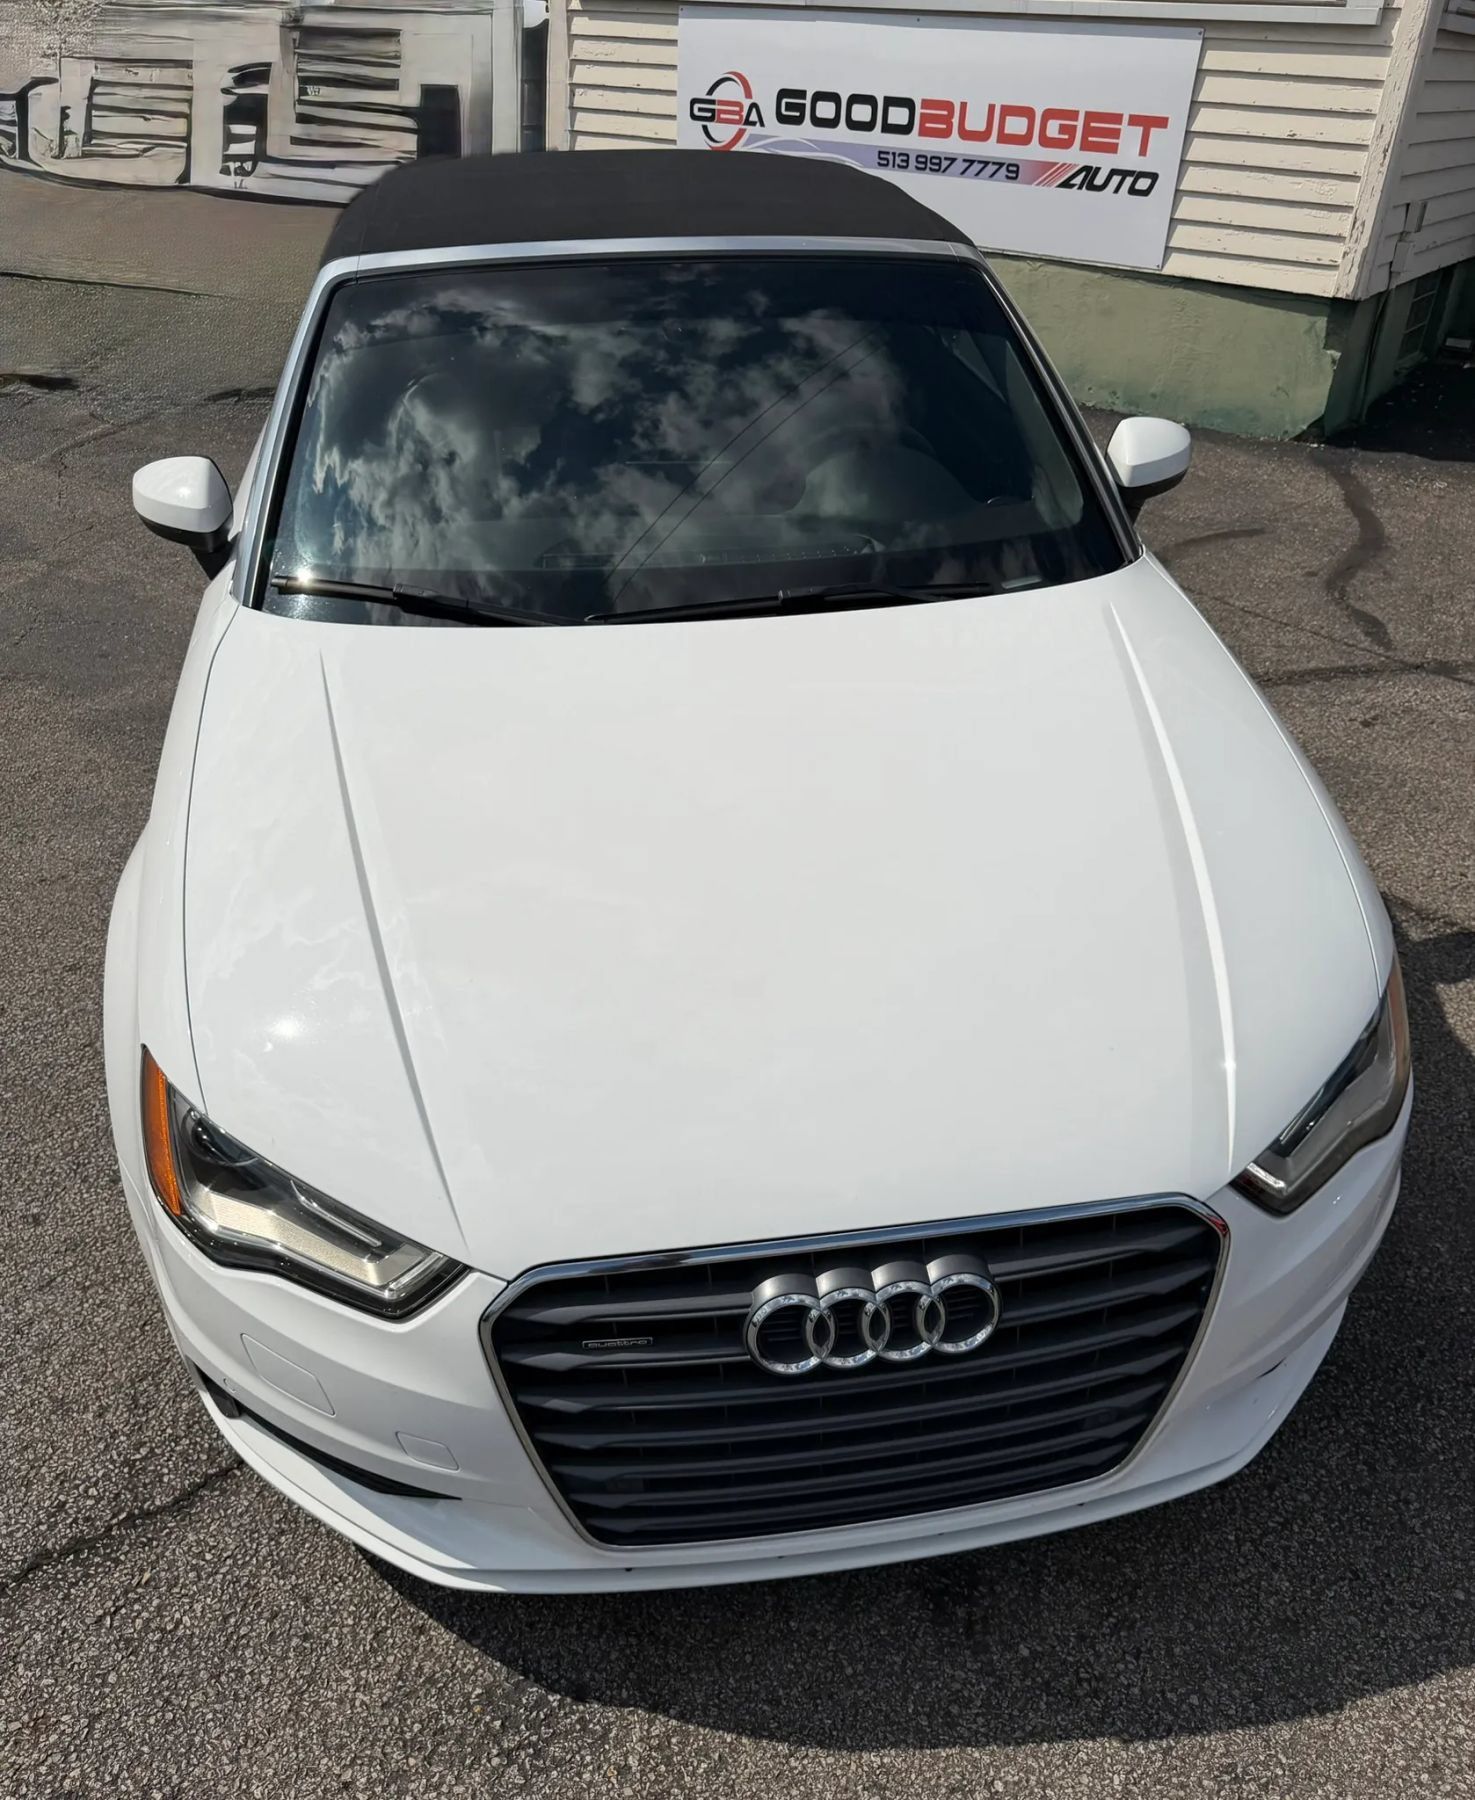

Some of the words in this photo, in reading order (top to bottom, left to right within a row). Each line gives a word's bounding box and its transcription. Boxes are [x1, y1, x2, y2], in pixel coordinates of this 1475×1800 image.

[689, 97, 765, 128] GBA
[877, 150, 910, 170] 513
[915, 154, 957, 174] 997
[960, 158, 1020, 180] 7779
[1056, 165, 1159, 197] AUTO
[588, 1340, 648, 1349] quattro
